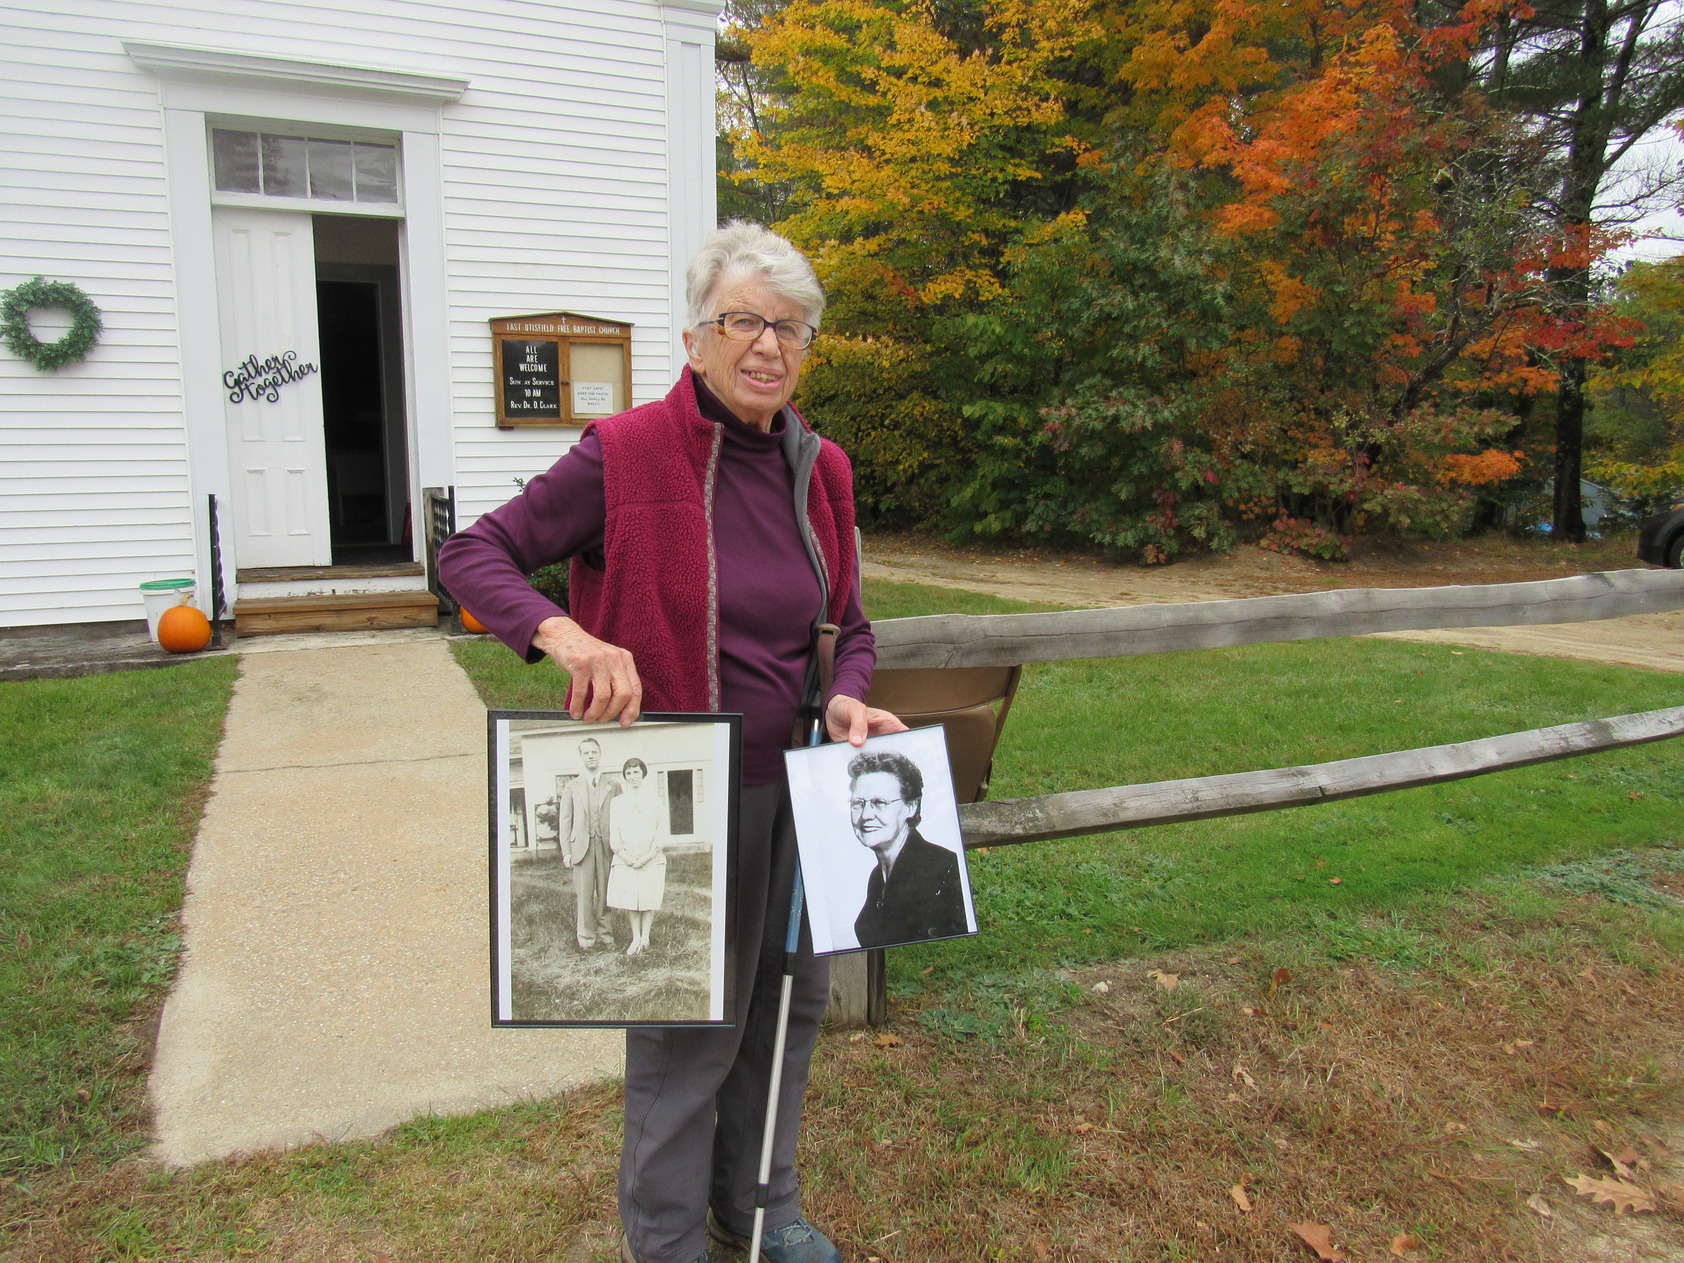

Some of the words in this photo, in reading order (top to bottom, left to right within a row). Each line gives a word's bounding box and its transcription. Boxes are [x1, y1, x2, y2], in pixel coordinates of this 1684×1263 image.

[506, 323, 522, 332] EAST
[524, 323, 554, 333] OTISFIELD
[557, 324, 570, 333] FREE
[573, 325, 597, 334] BAPTIST
[599, 326, 620, 335] CHURCH
[525, 346, 538, 354] ALL
[526, 355, 538, 363] ARE
[519, 363, 548, 373] WELCOME
[223, 350, 297, 403] Gather
[240, 358, 319, 403] together
[524, 389, 531, 397] 10
[532, 389, 541, 397] AM
